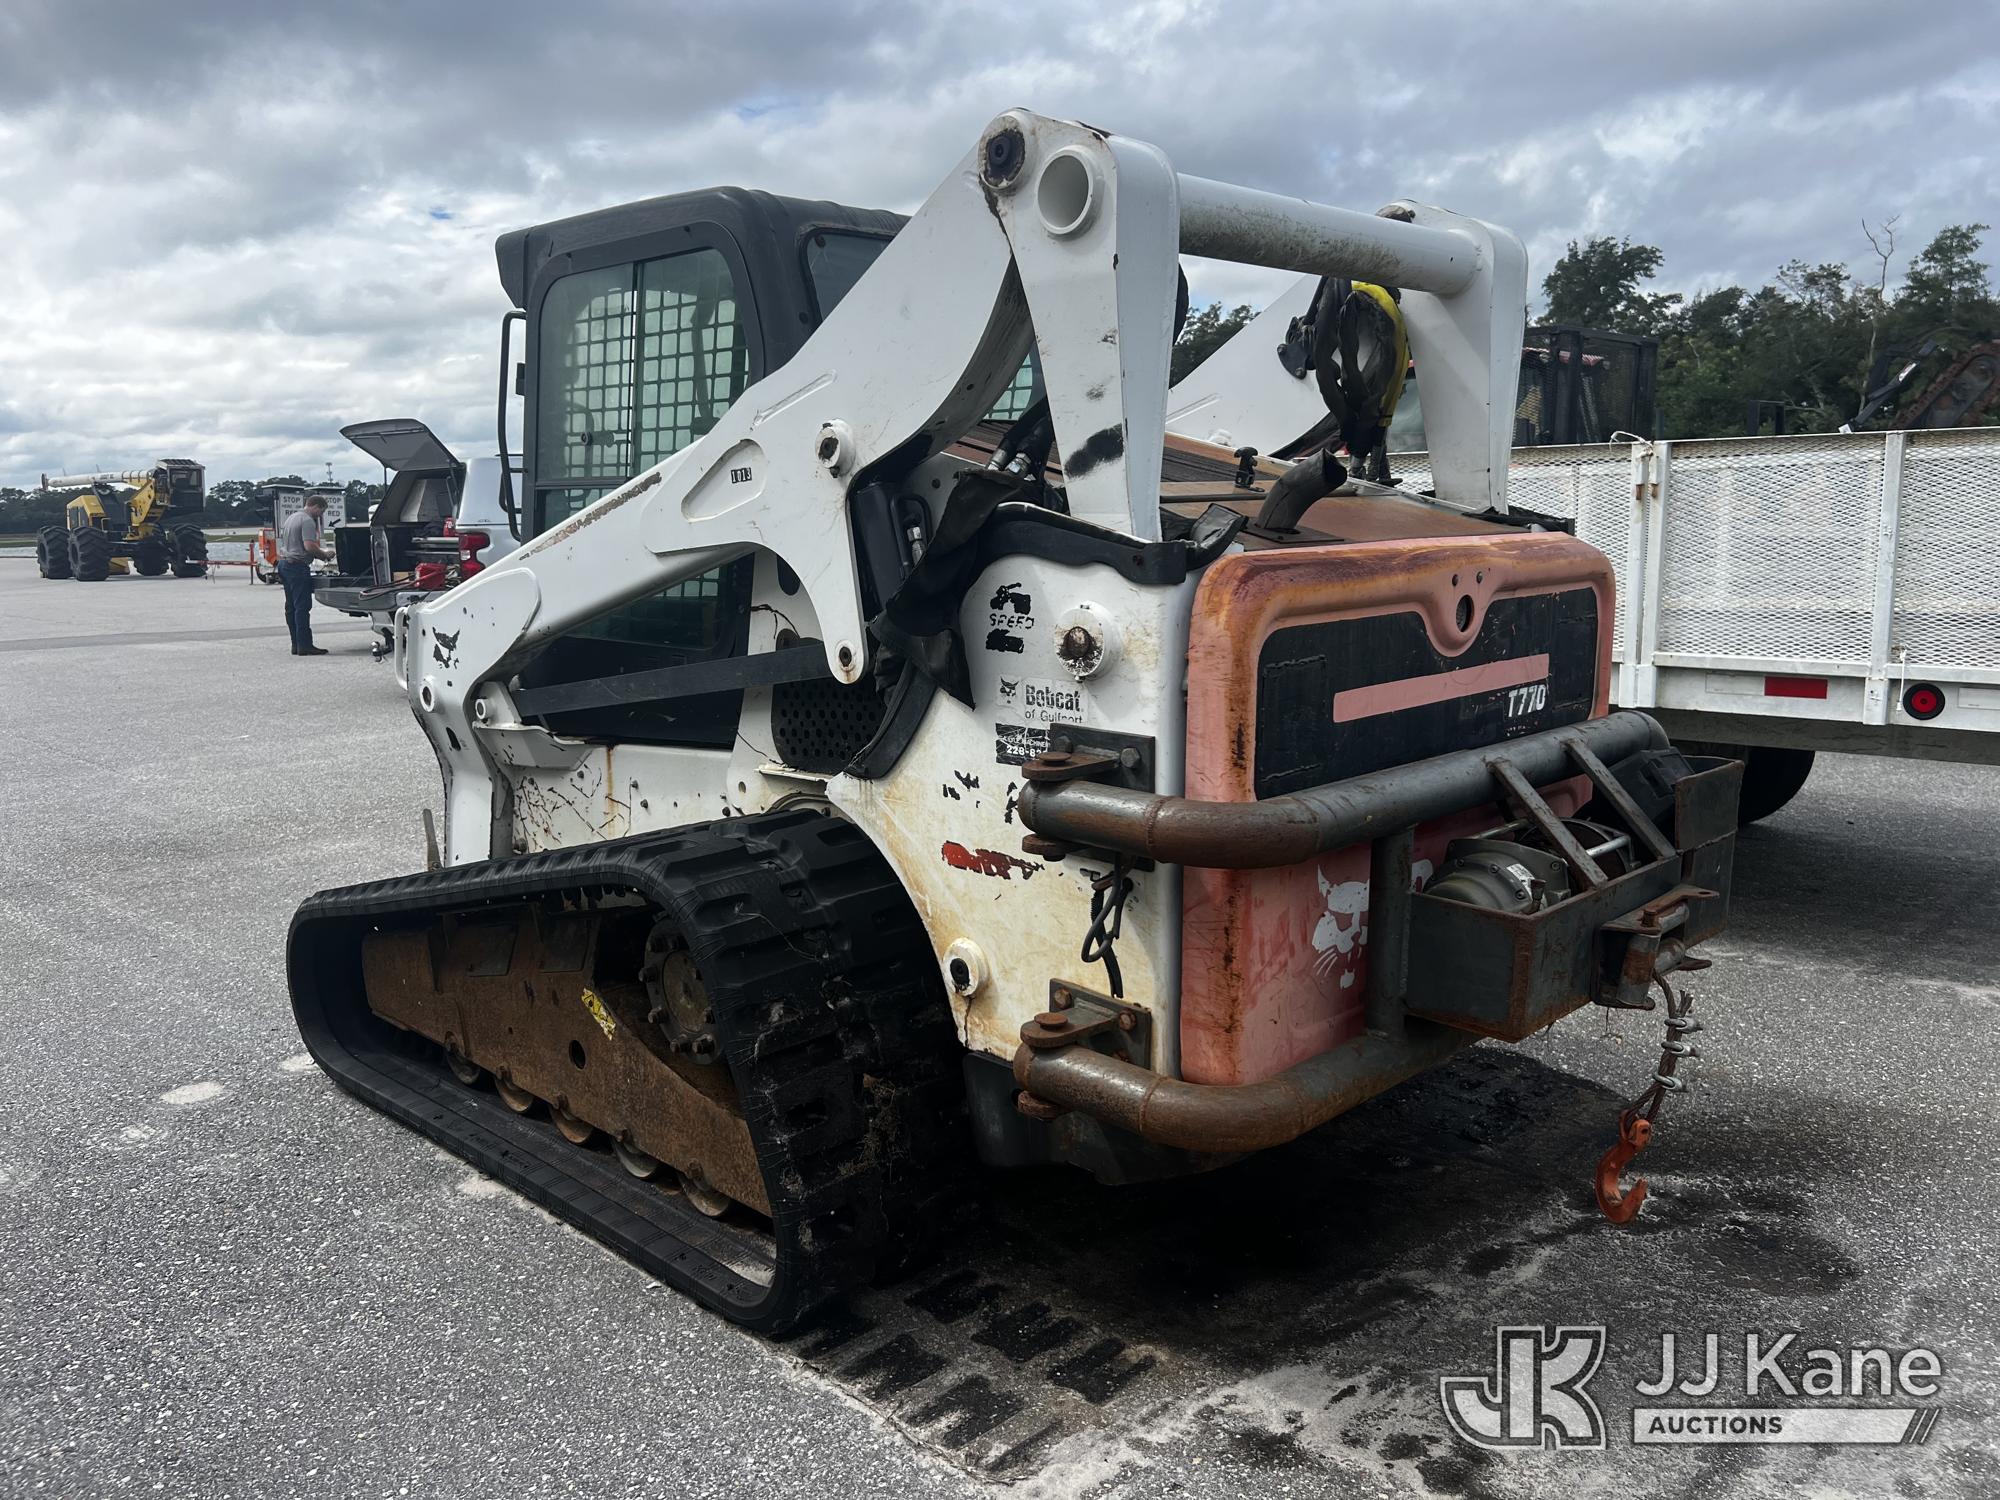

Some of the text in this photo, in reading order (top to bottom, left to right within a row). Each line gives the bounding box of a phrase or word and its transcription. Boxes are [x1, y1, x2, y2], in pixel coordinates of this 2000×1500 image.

[731, 468, 752, 483] 1013
[1025, 684, 1081, 712] Bobcat
[1508, 684, 1546, 718] T770
[1025, 709, 1036, 719] of
